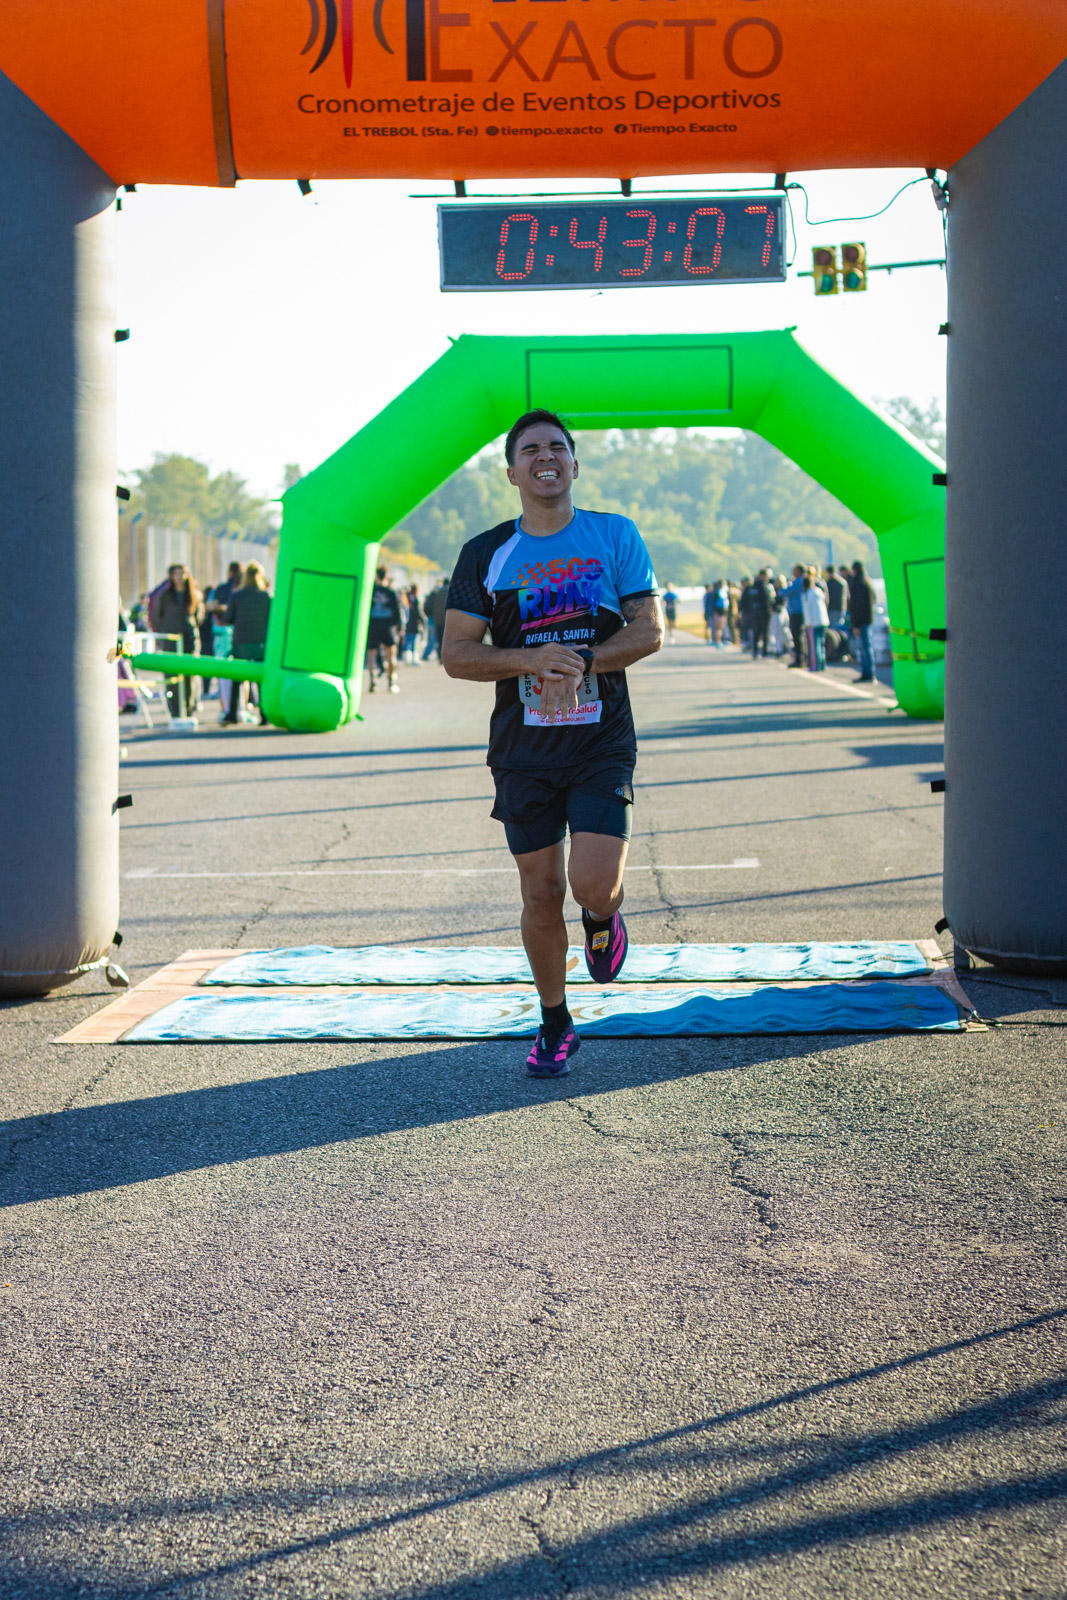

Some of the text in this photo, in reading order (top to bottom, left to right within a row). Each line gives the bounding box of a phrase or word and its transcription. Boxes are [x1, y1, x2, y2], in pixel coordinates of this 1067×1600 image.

[298, 89, 781, 117] Cronometraje de Eventos Deportivos
[343, 123, 738, 138] EL TREBOL (Sta. Fe) tiempo.exacto Tiempo Exacto
[496, 206, 775, 281] 0:43:07
[525, 631, 561, 645] RAFAELA,
[562, 629, 589, 641] SANTA
[524, 672, 532, 698] EMPO
[575, 703, 598, 714] Salud
